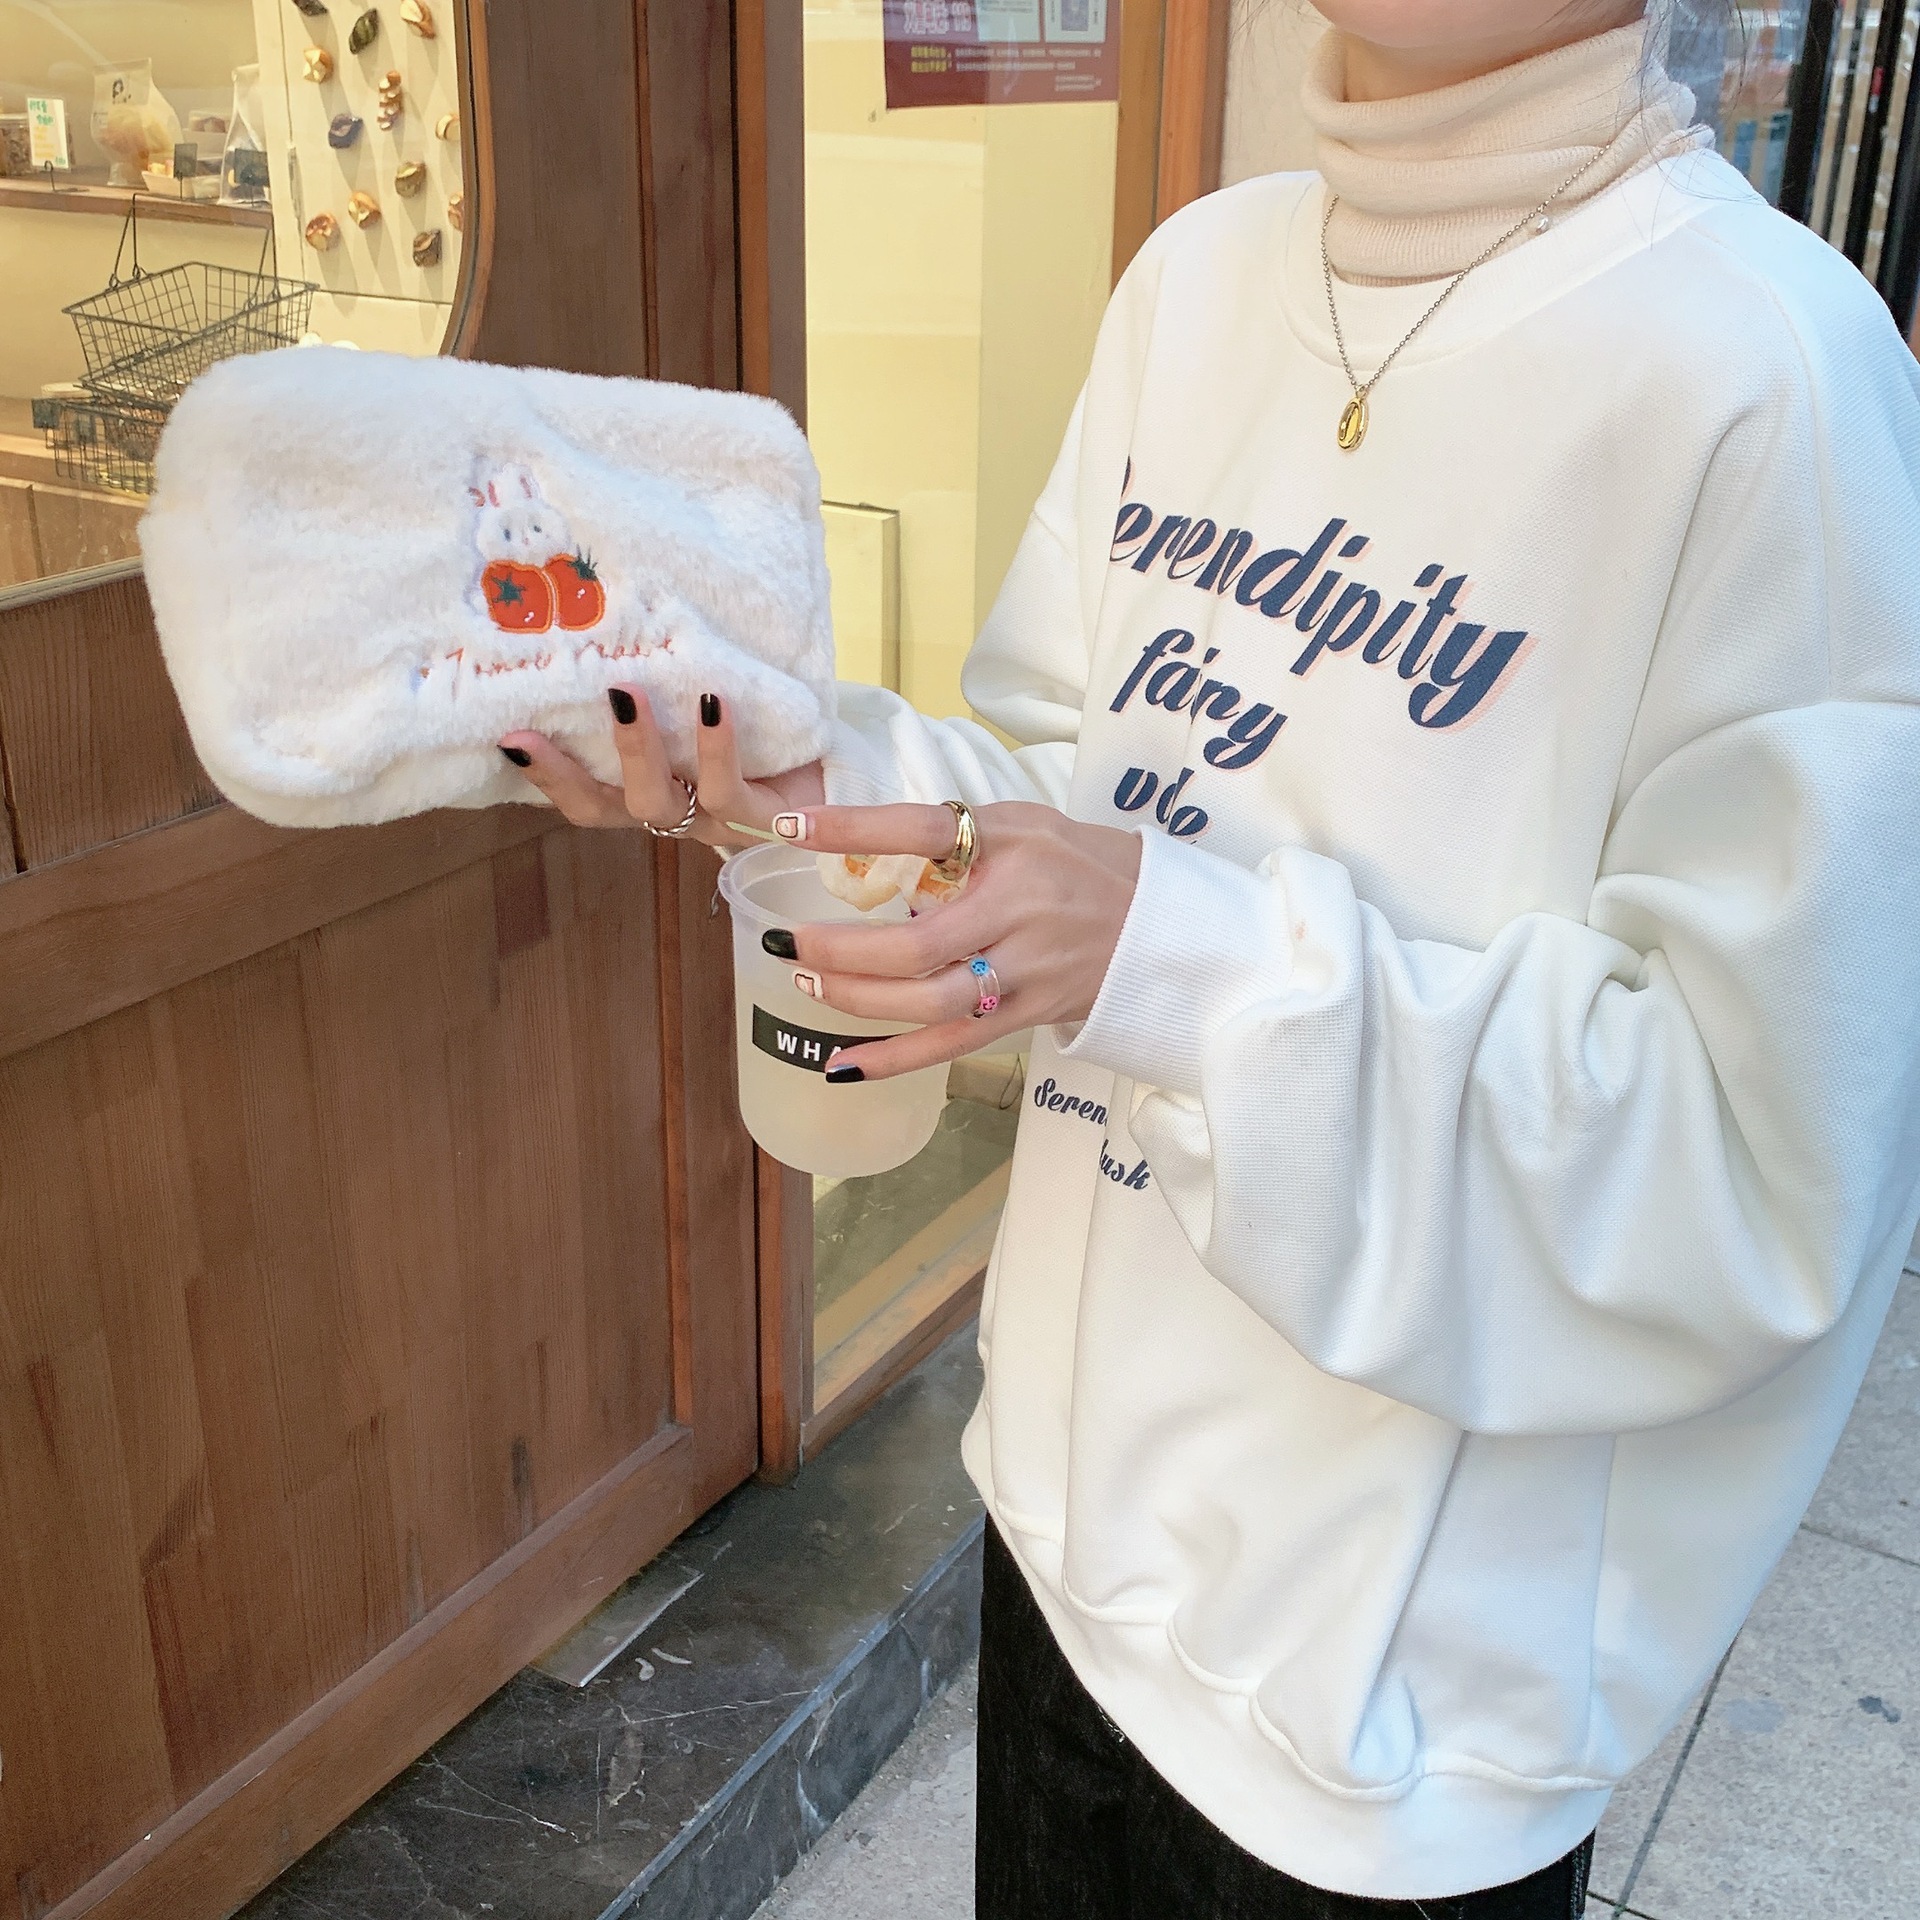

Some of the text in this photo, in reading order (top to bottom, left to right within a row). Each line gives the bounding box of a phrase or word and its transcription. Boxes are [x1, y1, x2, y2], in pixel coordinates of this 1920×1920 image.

[1109, 456, 1533, 730] erendipity
[1109, 628, 1289, 770] fairy
[1034, 1078, 1108, 1127] Seren
